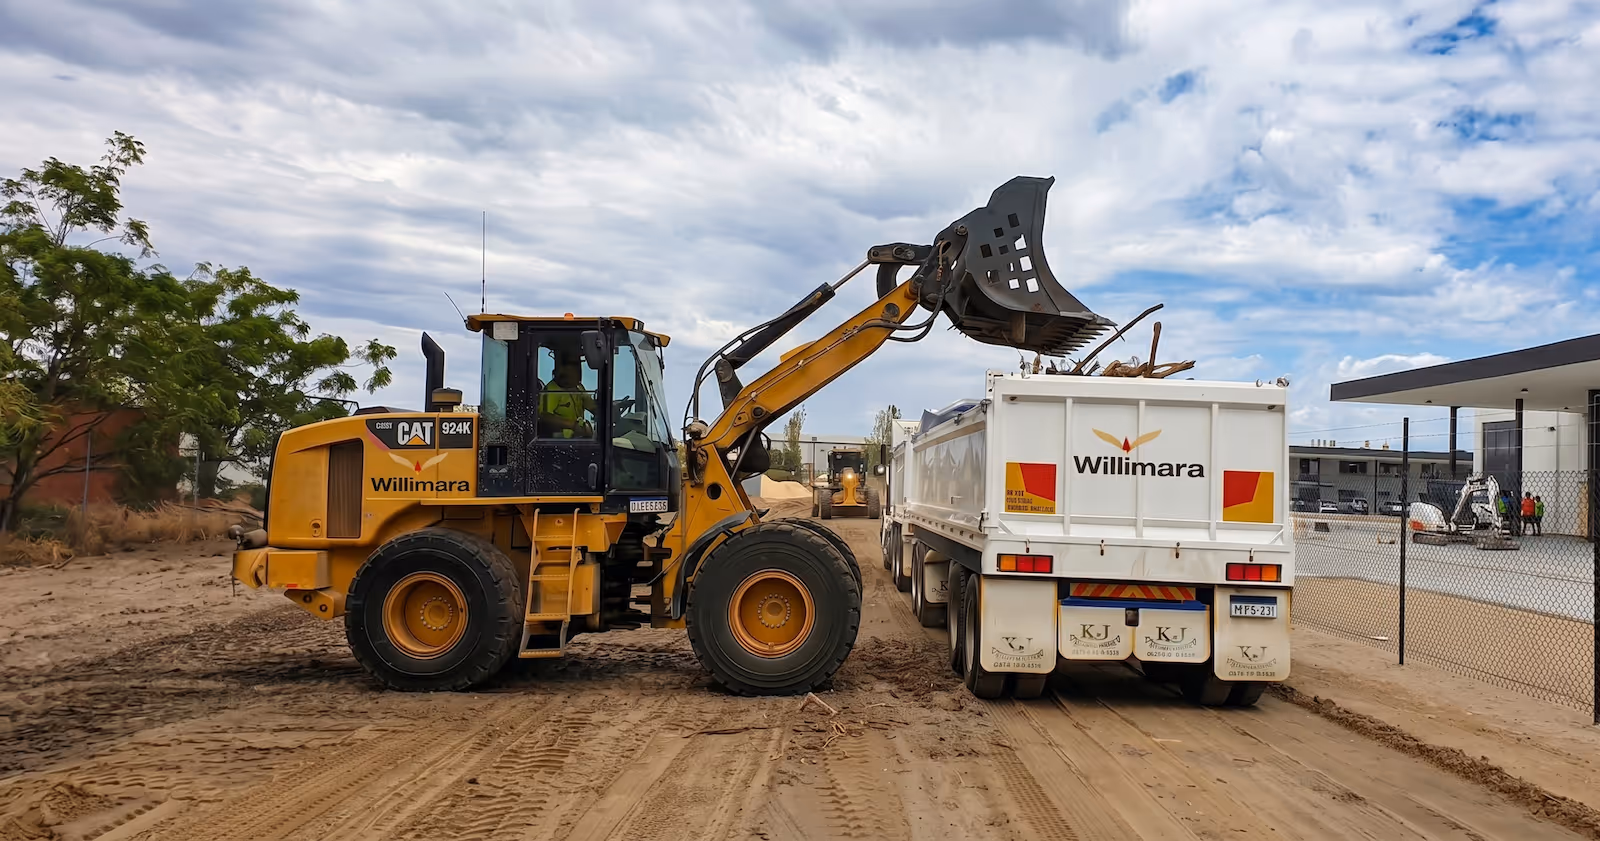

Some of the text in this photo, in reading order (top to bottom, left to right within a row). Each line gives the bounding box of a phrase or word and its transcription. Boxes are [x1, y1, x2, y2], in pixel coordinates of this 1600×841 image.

[397, 421, 434, 445] CAT
[442, 422, 471, 435] 924K
[1073, 455, 1205, 478] Willimara
[371, 477, 470, 492] Willimara
